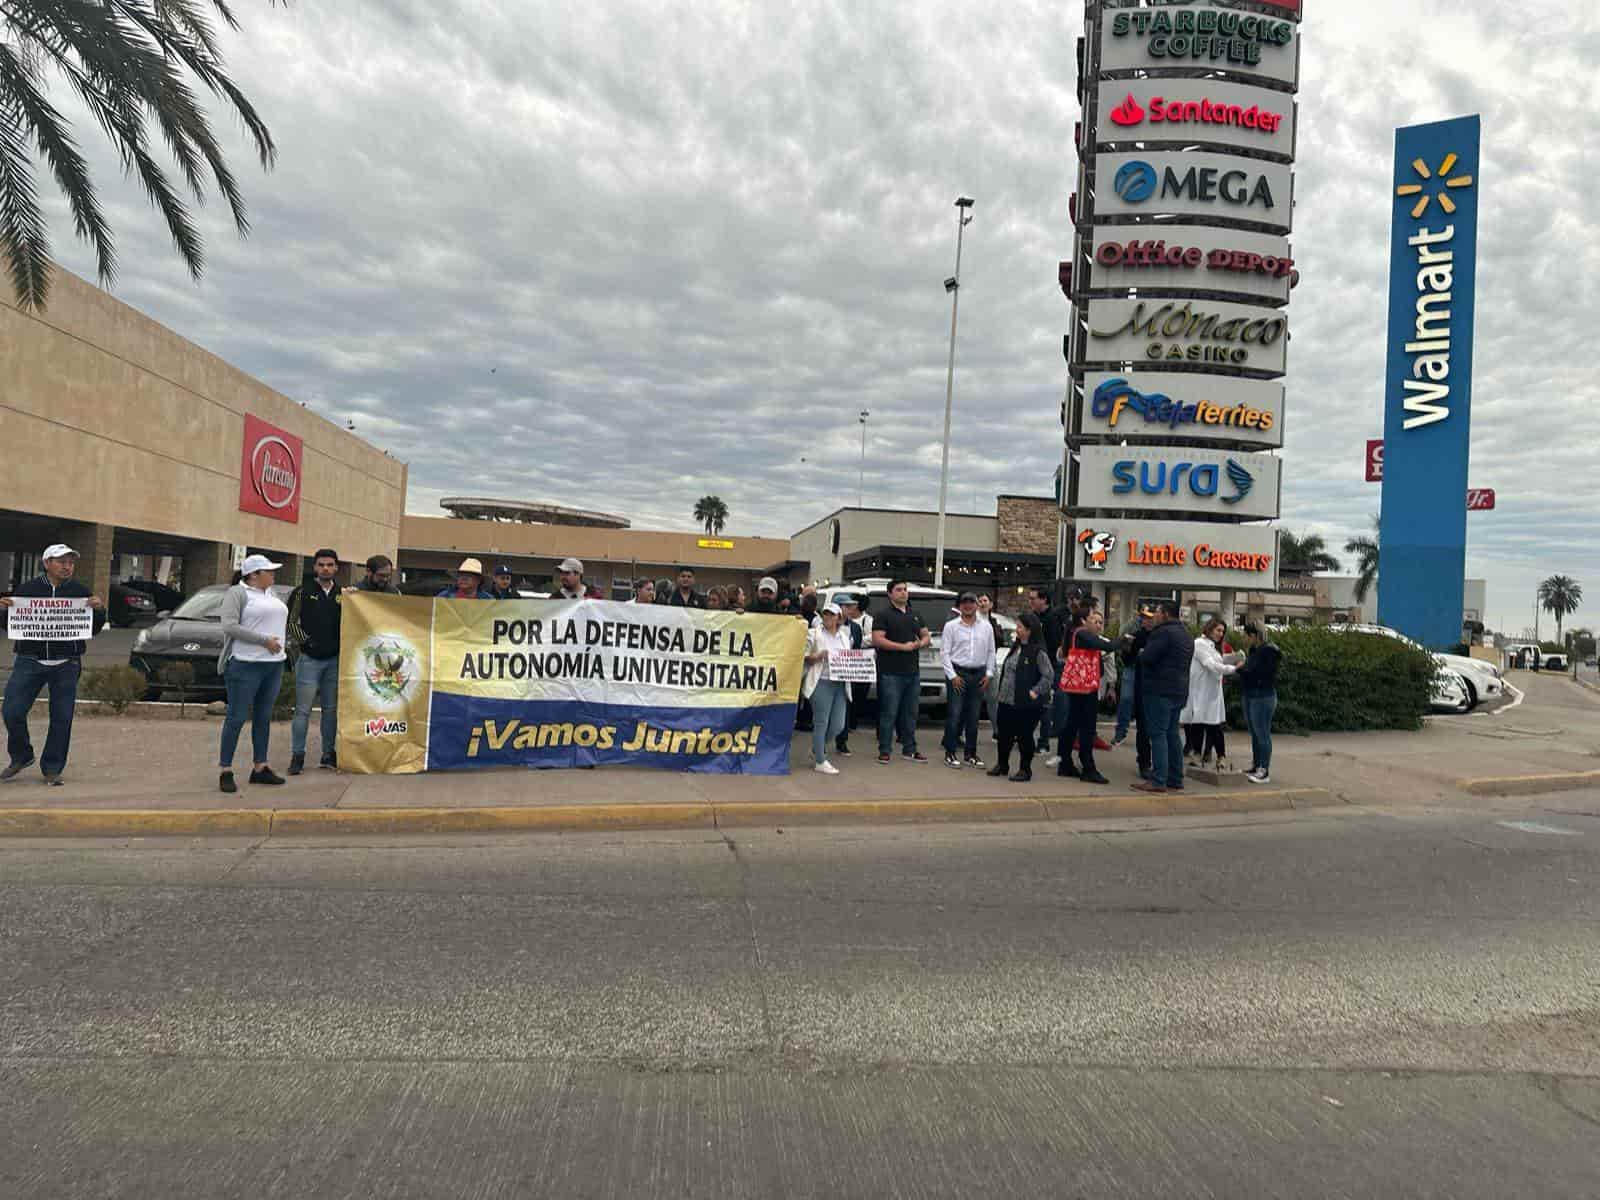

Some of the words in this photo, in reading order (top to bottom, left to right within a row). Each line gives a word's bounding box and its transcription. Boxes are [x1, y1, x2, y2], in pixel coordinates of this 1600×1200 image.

[1113, 10, 1292, 46] STARBUCKS
[1148, 35, 1261, 65] COFFEE
[1149, 97, 1282, 132] Santander
[1161, 166, 1274, 208] MEGA
[1096, 240, 1202, 266] Office
[1207, 247, 1294, 276] DEPOT
[1091, 302, 1285, 345] Mónaco
[1402, 224, 1455, 430] Walmart
[1146, 343, 1248, 363] CASINO
[1112, 460, 1219, 496] sura
[1128, 539, 1187, 565] Little
[1195, 542, 1272, 572] Caesars
[493, 619, 543, 645] POR
[551, 619, 578, 645] LA
[585, 619, 685, 653] DEFENSA
[693, 629, 722, 655] DE
[729, 631, 754, 657] LA
[460, 646, 604, 680] AUTONOMÍA
[613, 655, 777, 691] UNIVERSITARIA
[467, 719, 617, 757] ¡Vamos
[622, 721, 761, 754] Juntos!
